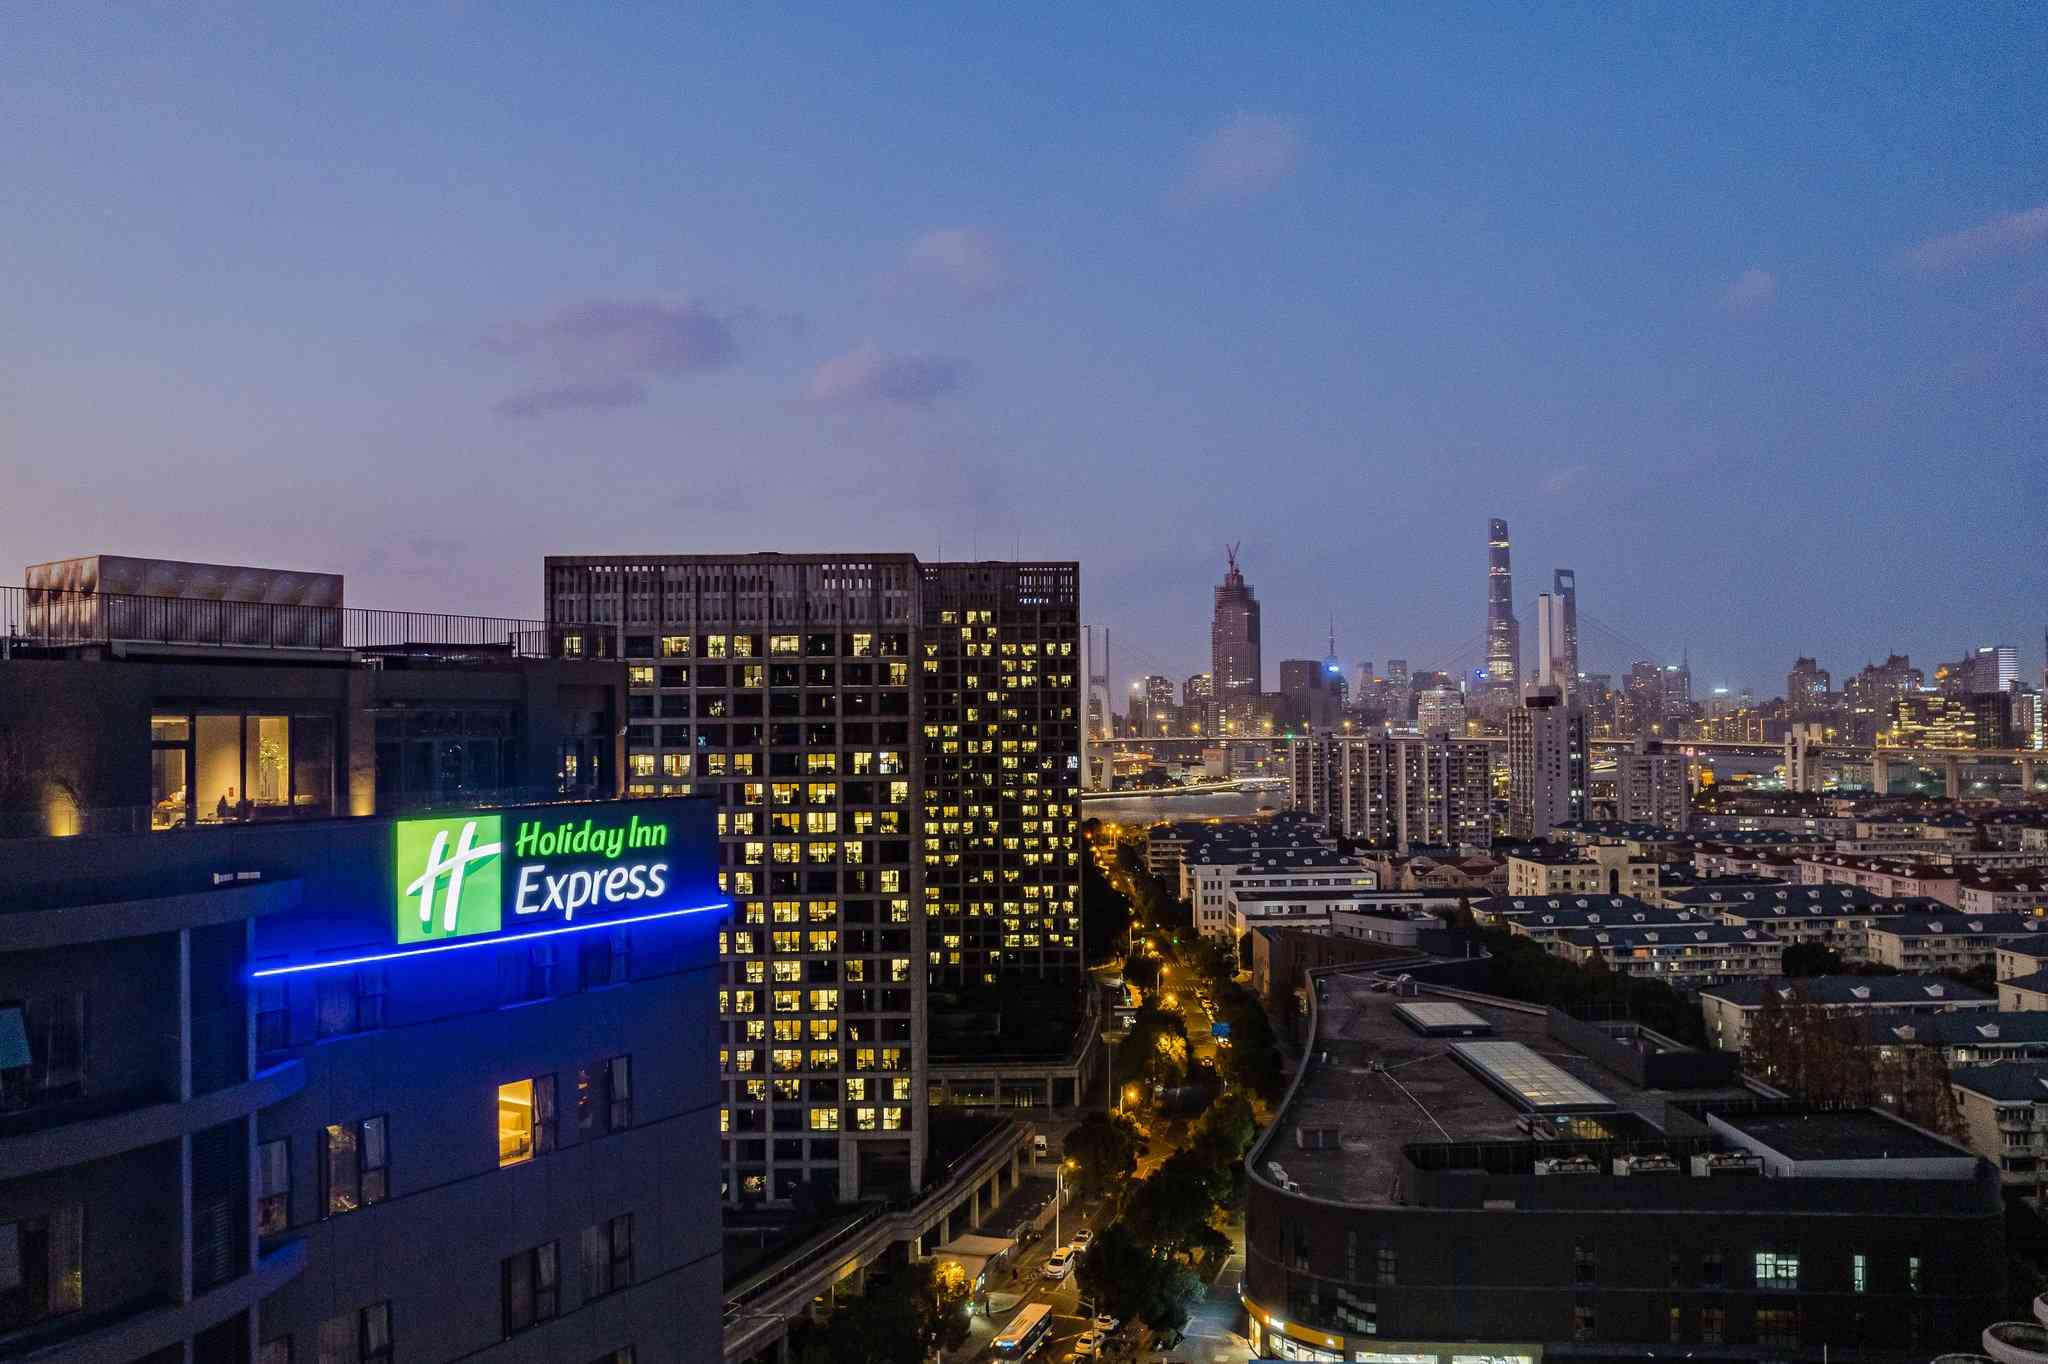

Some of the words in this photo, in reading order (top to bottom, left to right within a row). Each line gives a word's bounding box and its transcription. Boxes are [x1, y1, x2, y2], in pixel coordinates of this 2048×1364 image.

[515, 819, 624, 859] Holiday
[629, 815, 667, 848] Inn
[514, 863, 669, 921] Express
